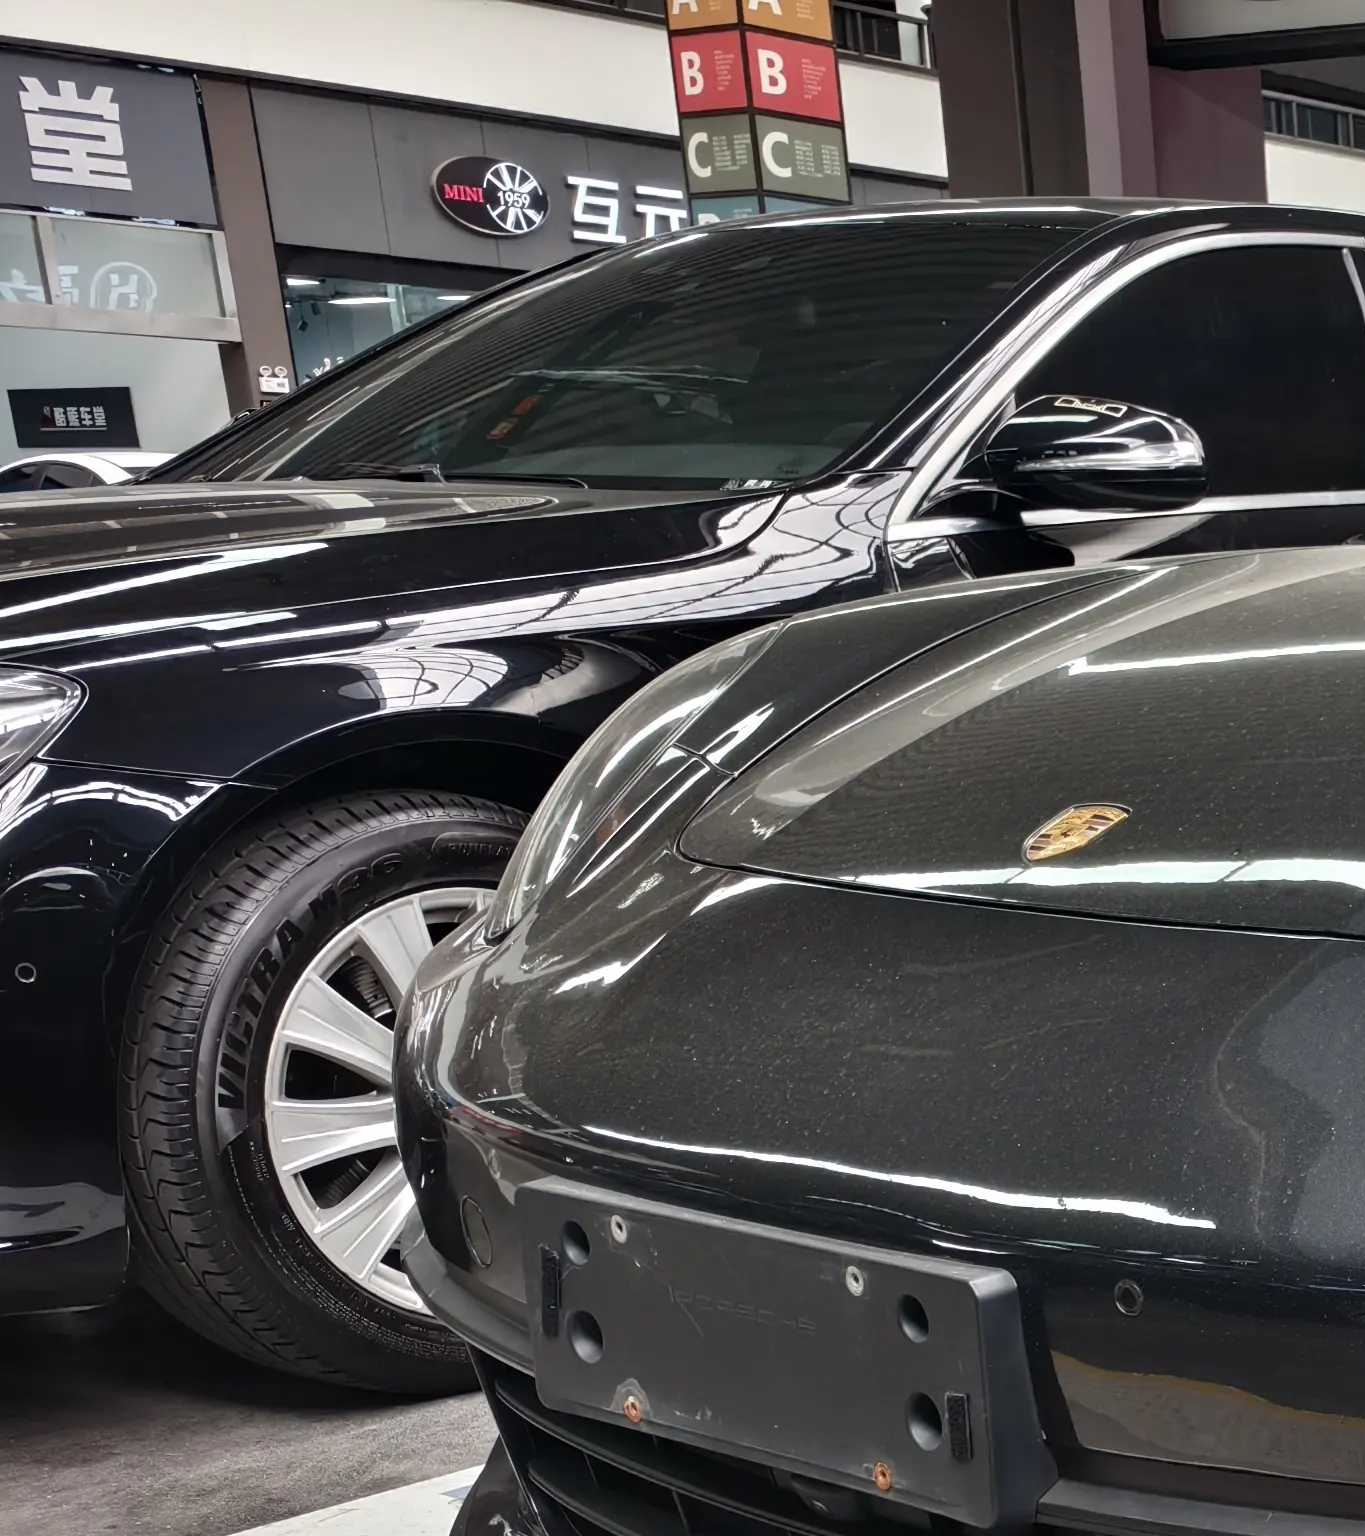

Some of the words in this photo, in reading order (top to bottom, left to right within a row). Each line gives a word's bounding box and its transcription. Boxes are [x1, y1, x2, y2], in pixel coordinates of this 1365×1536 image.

[680, 51, 704, 95] B
[758, 49, 787, 94] B
[18, 75, 133, 191] 堂
[688, 132, 712, 178] C
[762, 131, 793, 178] C
[443, 184, 484, 204] MINI
[497, 191, 531, 208] 1959
[216, 918, 304, 1110] VICTRA
[671, 1288, 817, 1335] PORSCHE
